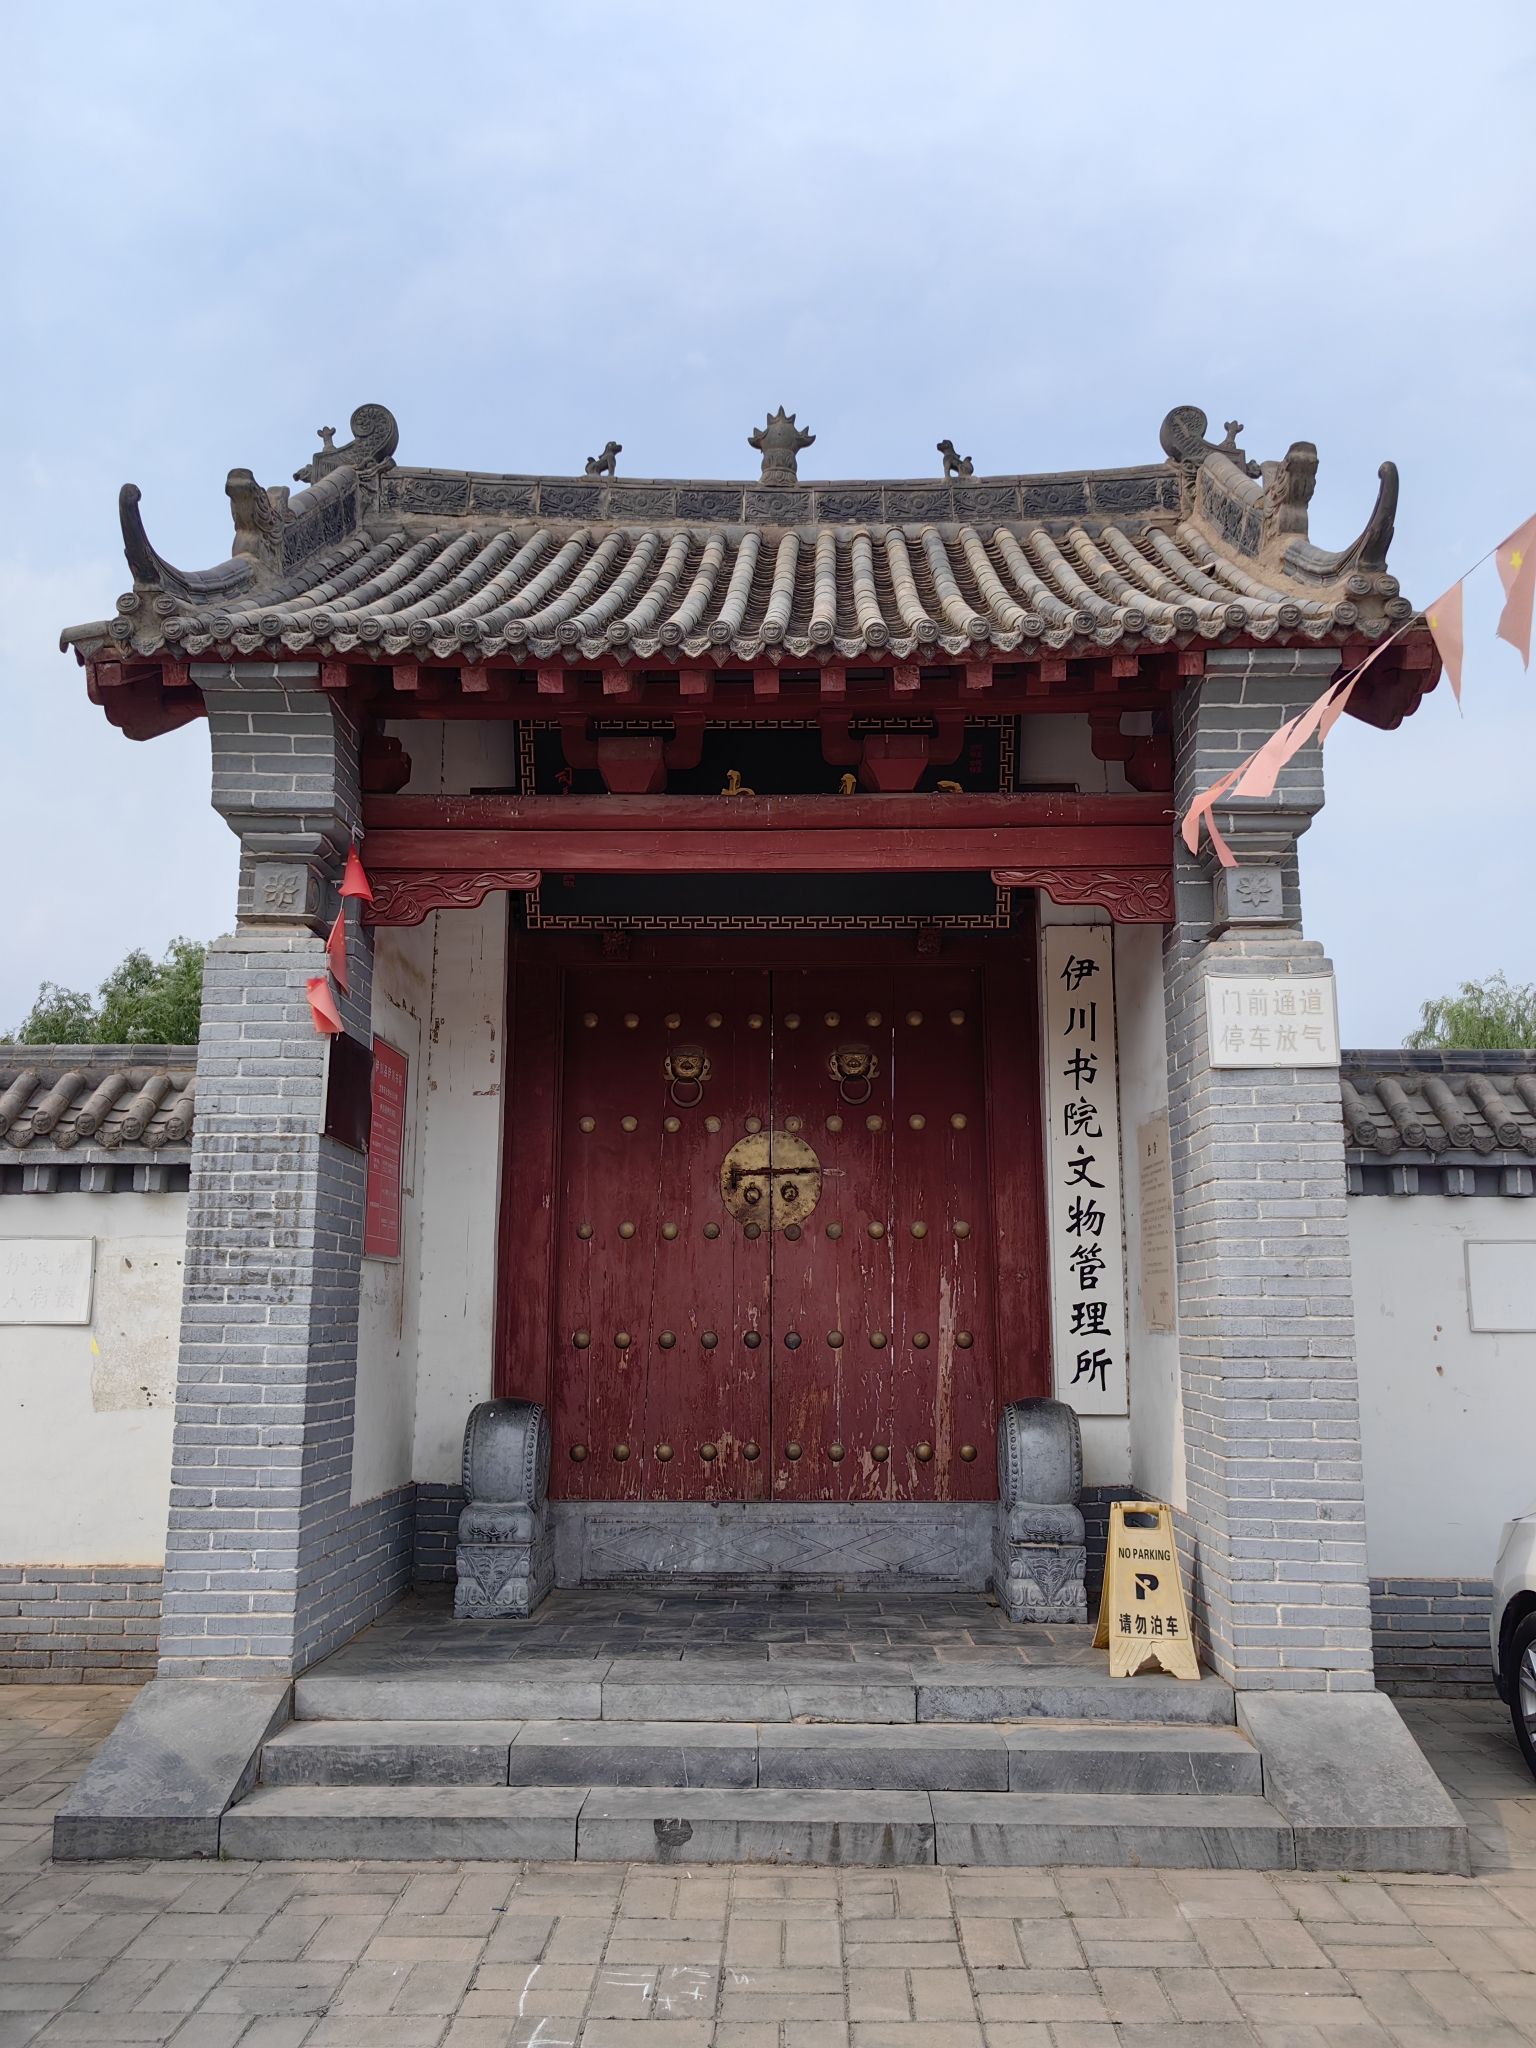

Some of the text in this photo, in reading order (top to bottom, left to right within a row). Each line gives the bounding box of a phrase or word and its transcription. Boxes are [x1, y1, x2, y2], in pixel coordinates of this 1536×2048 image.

[1221, 988, 1324, 1017] 门前通道
[1219, 1024, 1326, 1053] 停车放气
[1060, 954, 1113, 1392] 伊川书院文物管理所
[1118, 1547, 1171, 1561] NO PARKING
[1119, 1613, 1179, 1637] 请勿泊车
